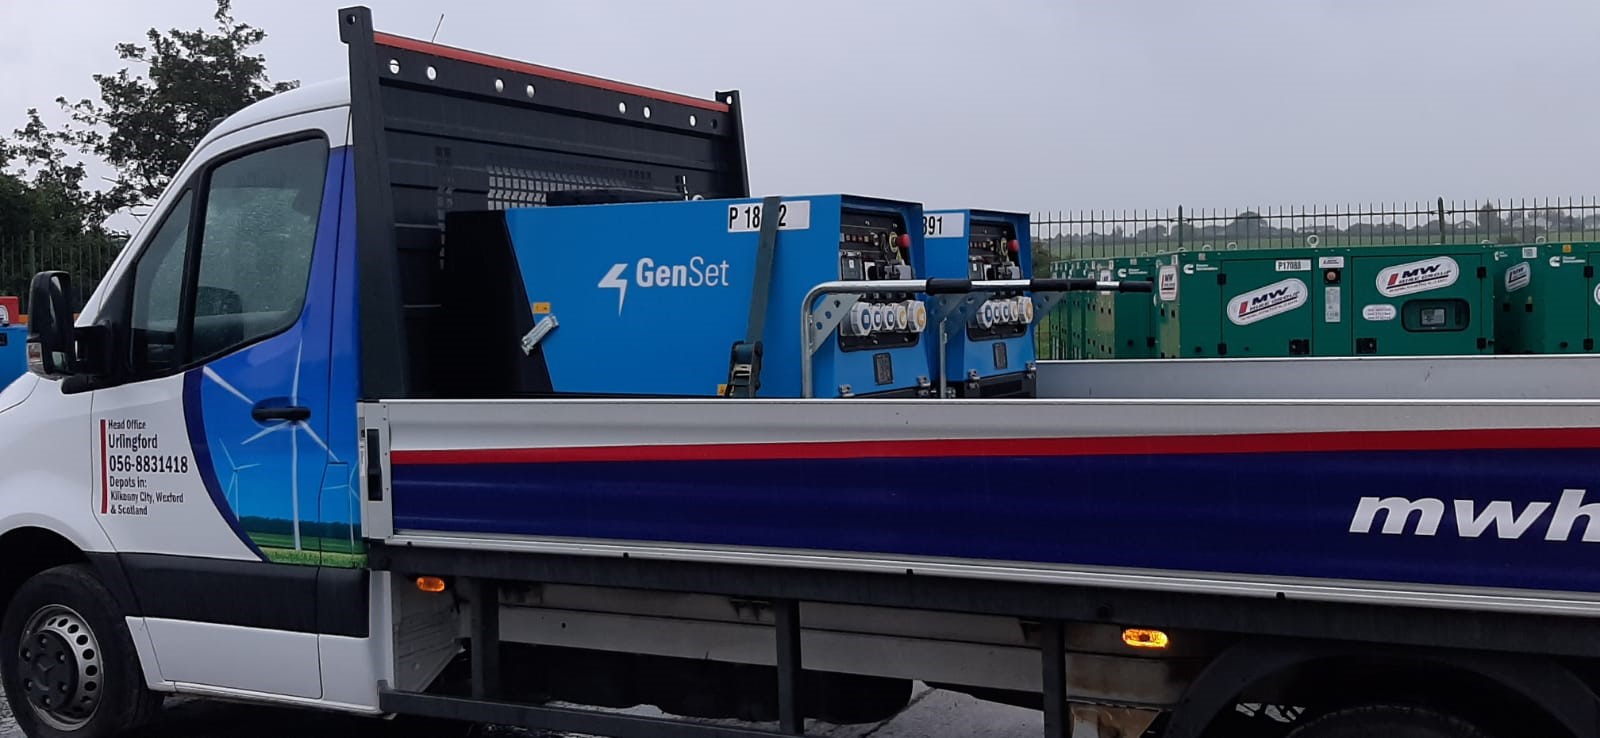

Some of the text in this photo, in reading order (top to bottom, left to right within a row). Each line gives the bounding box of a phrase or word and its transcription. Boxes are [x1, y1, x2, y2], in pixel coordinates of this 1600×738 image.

[729, 204, 787, 229] P 182
[636, 256, 730, 288] GenSet
[1402, 264, 1442, 278] MW
[1252, 287, 1289, 305] MW
[108, 419, 146, 430] Head Office
[108, 433, 158, 452] Urlingford
[109, 455, 188, 474] 056-8831418
[109, 476, 147, 489] Depots in:
[139, 491, 155, 504] City,
[156, 492, 184, 503] Wexford
[110, 504, 148, 516] & Scotland
